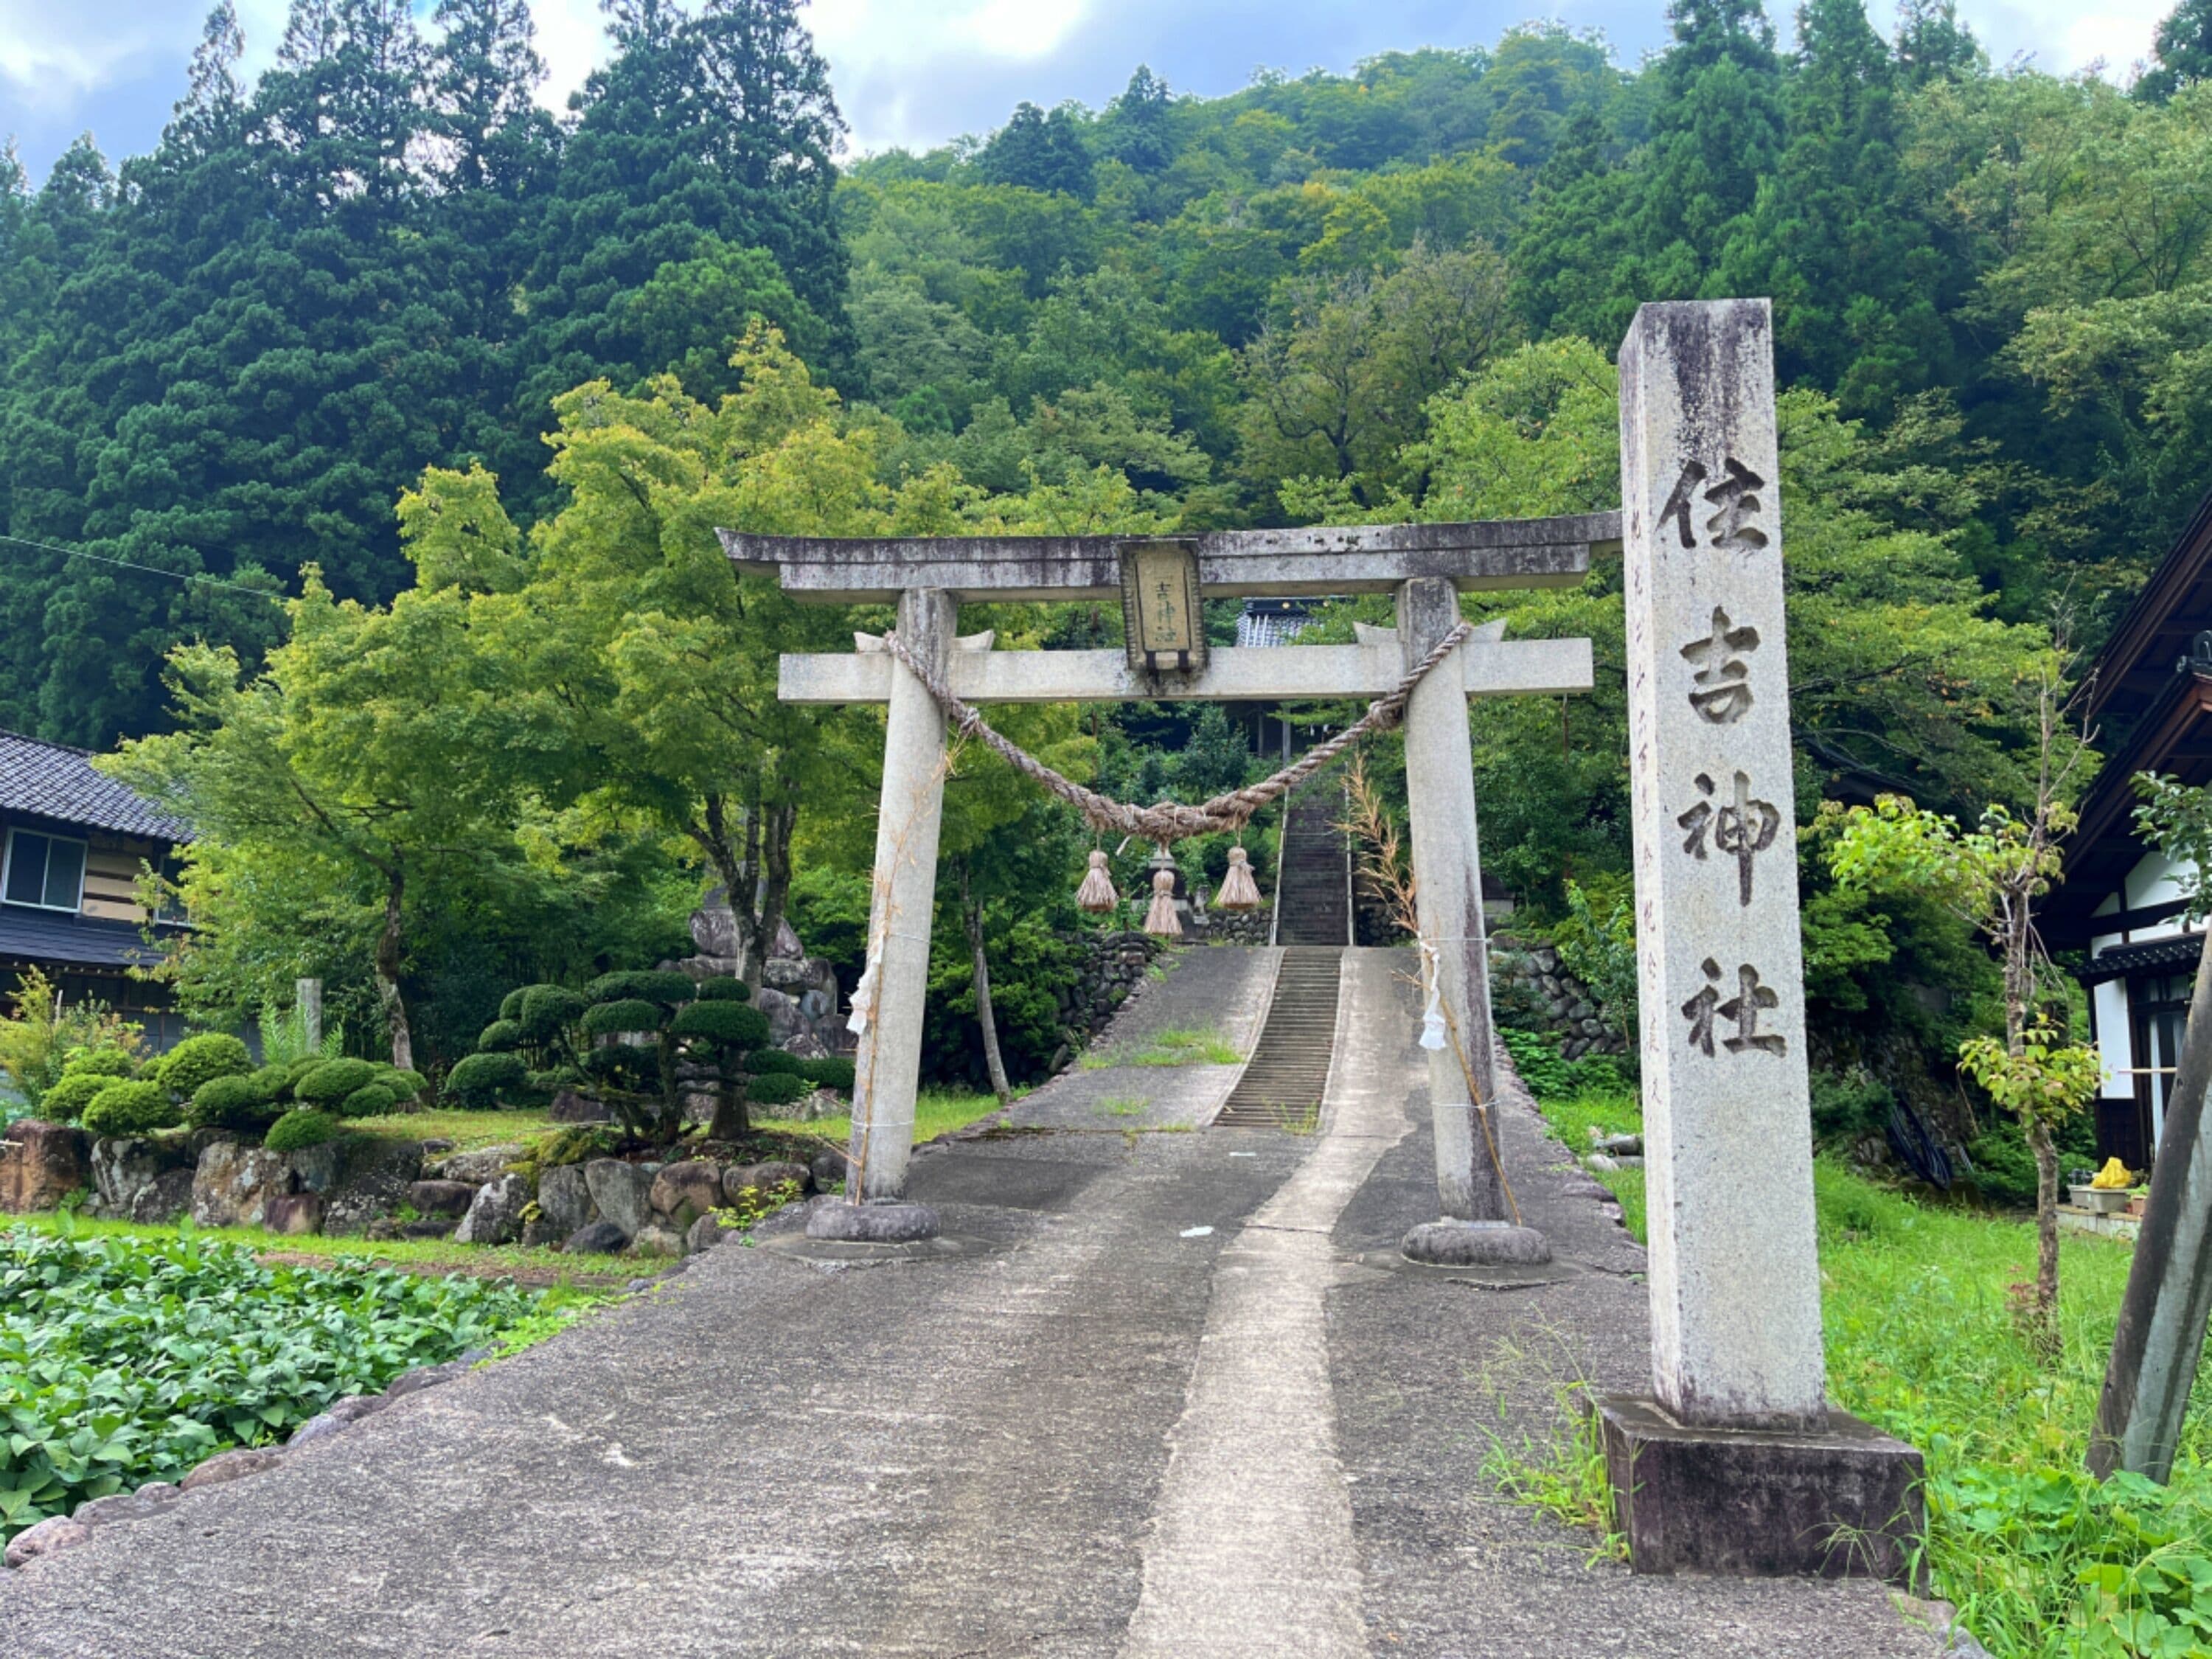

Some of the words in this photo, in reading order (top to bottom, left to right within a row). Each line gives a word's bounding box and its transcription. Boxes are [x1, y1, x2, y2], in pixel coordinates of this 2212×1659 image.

[1153, 568, 1177, 642] 吉神社
[1656, 457, 1787, 1057] 住吉神社
